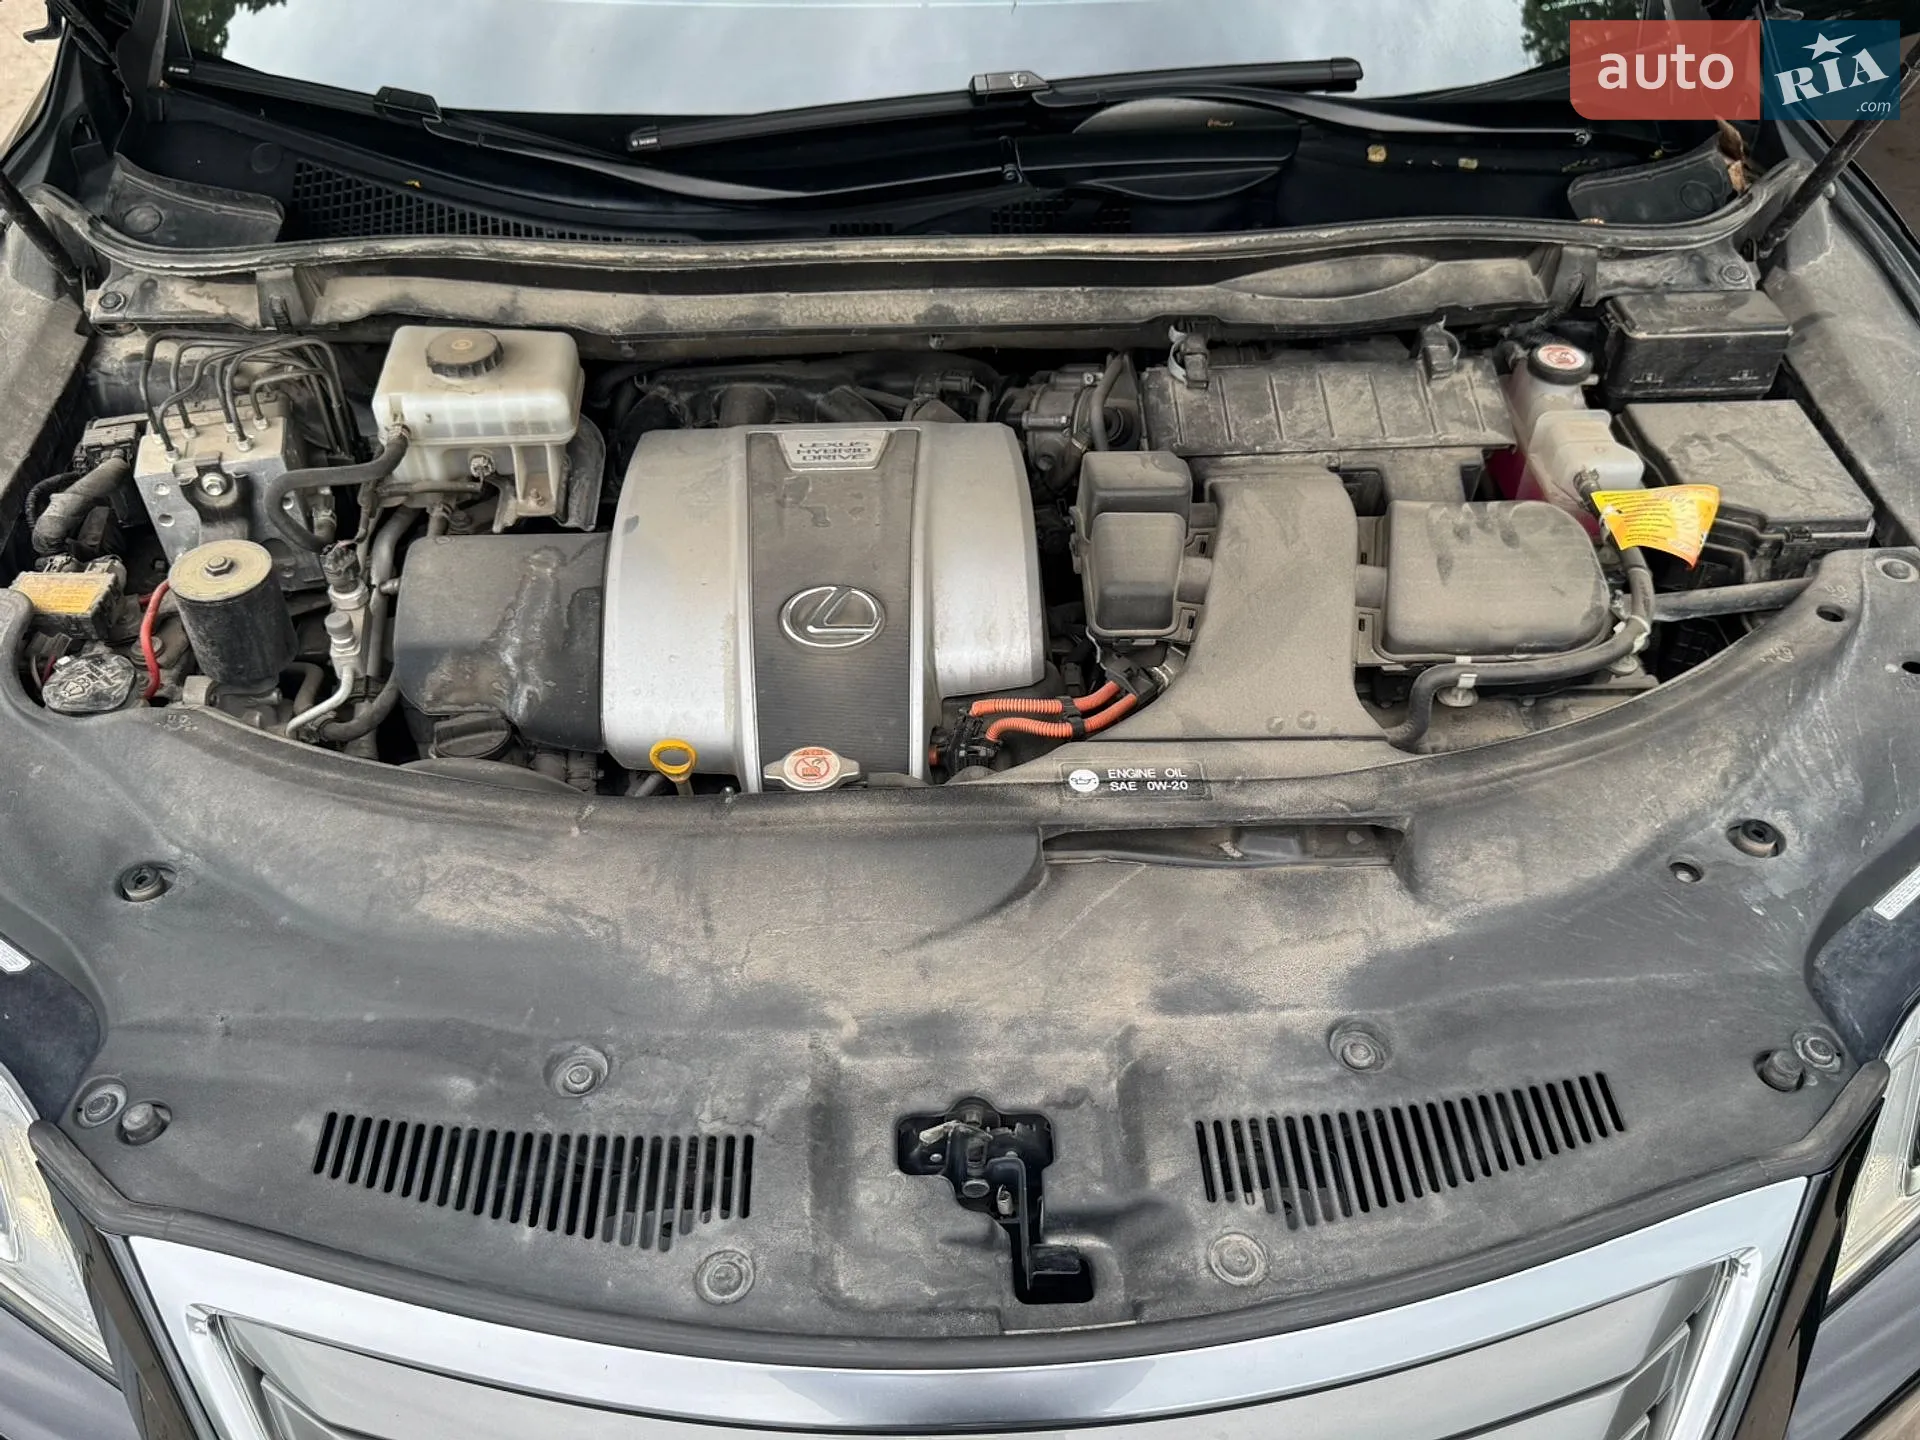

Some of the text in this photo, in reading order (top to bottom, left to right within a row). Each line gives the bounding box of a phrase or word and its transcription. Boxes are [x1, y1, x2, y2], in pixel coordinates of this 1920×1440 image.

[1107, 767, 1188, 779] ENGINE OIL
[1109, 780, 1189, 791] SAE 0W-20
